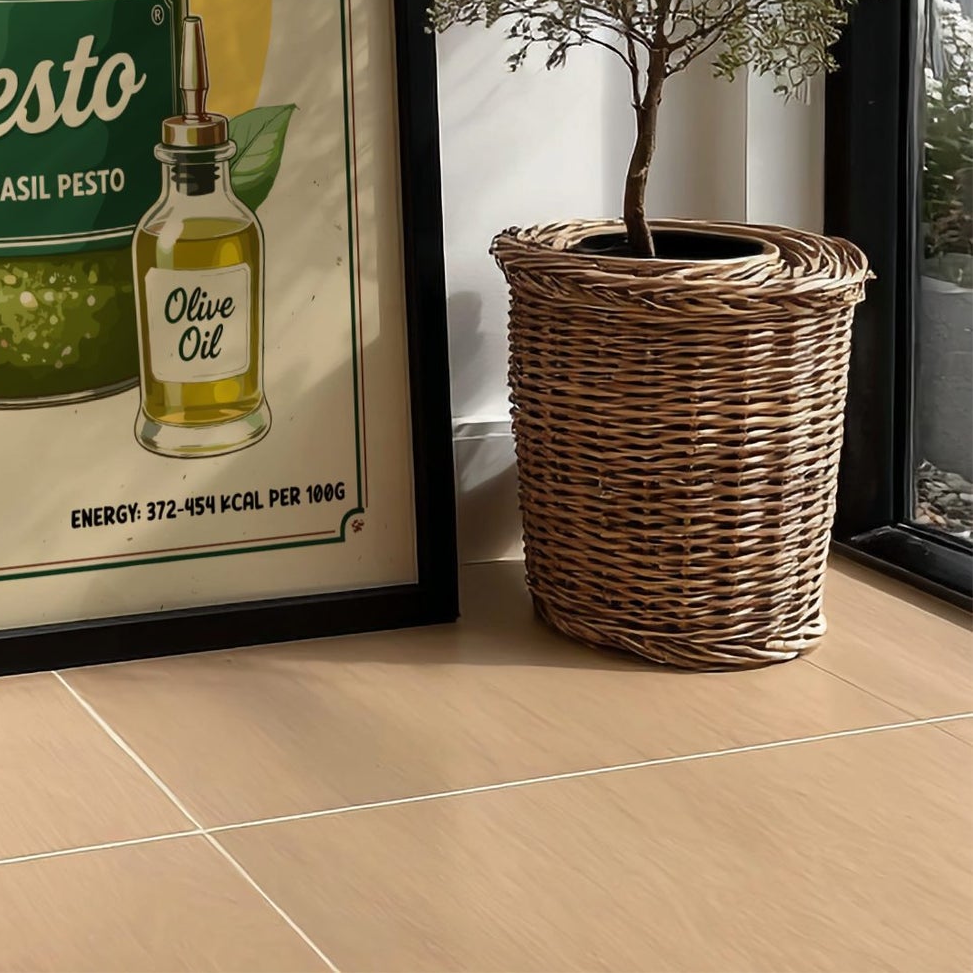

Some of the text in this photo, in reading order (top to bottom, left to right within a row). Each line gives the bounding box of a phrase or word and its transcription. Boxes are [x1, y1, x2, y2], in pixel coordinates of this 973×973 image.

[57, 168, 126, 199] PESTO
[164, 286, 236, 324] Olive
[178, 323, 224, 362] Oil
[70, 481, 346, 529] ENERGY: 372-454 KCAL PER 100G
